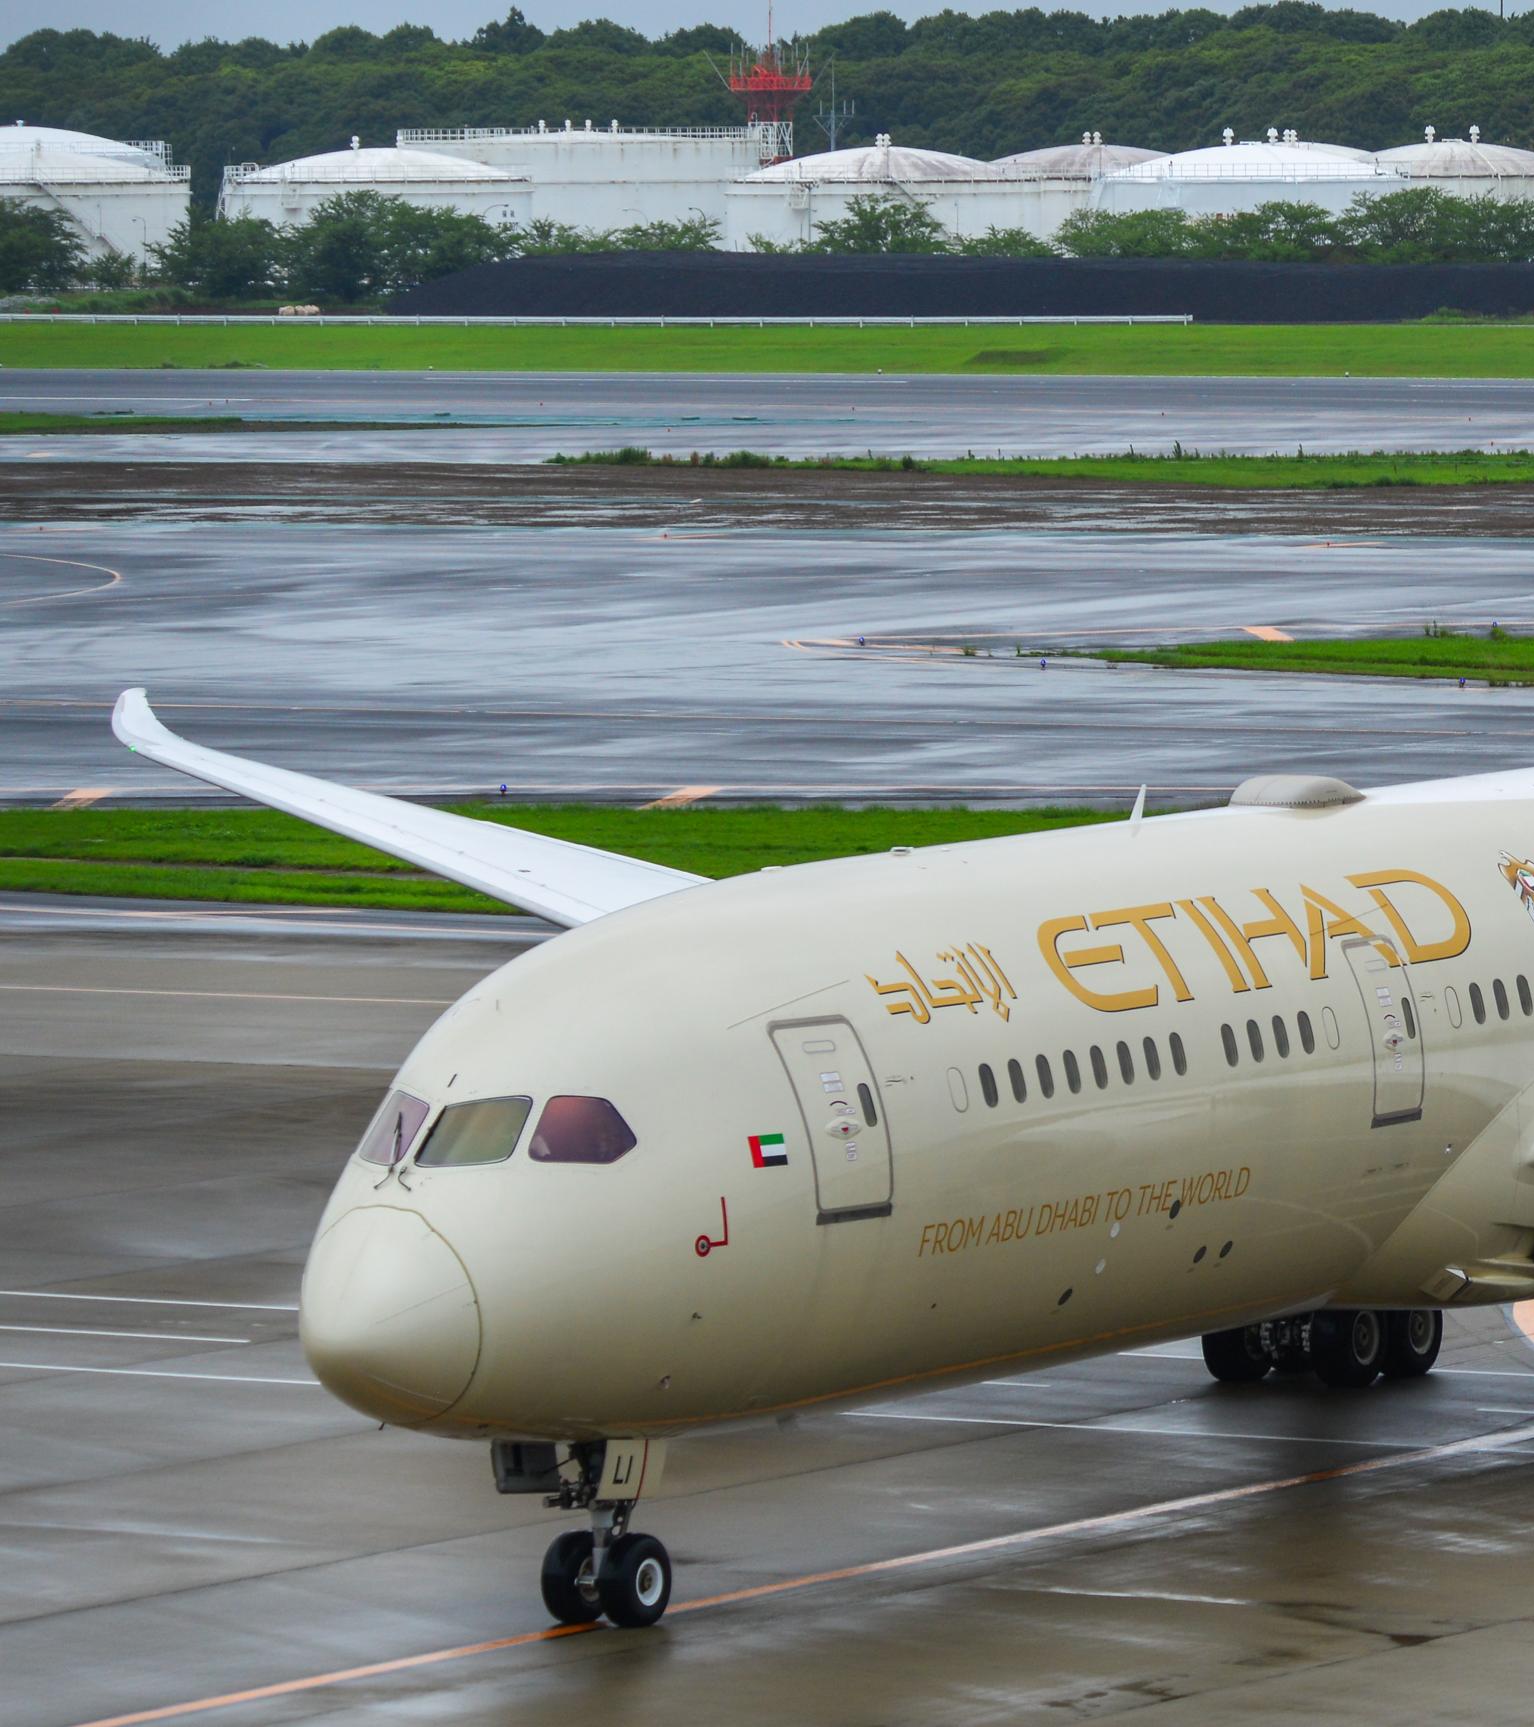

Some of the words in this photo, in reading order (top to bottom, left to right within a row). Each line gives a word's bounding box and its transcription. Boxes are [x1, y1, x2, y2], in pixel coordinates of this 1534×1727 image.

[1037, 868, 1471, 1012] ETIHAD
[918, 1215, 985, 1257] FROM
[985, 1207, 1034, 1246] ABU
[1035, 1193, 1101, 1236] DHABI
[1103, 1187, 1132, 1223] TO
[1136, 1179, 1178, 1215] THE
[1178, 1166, 1251, 1208] WORLD
[612, 1455, 634, 1484] LI
